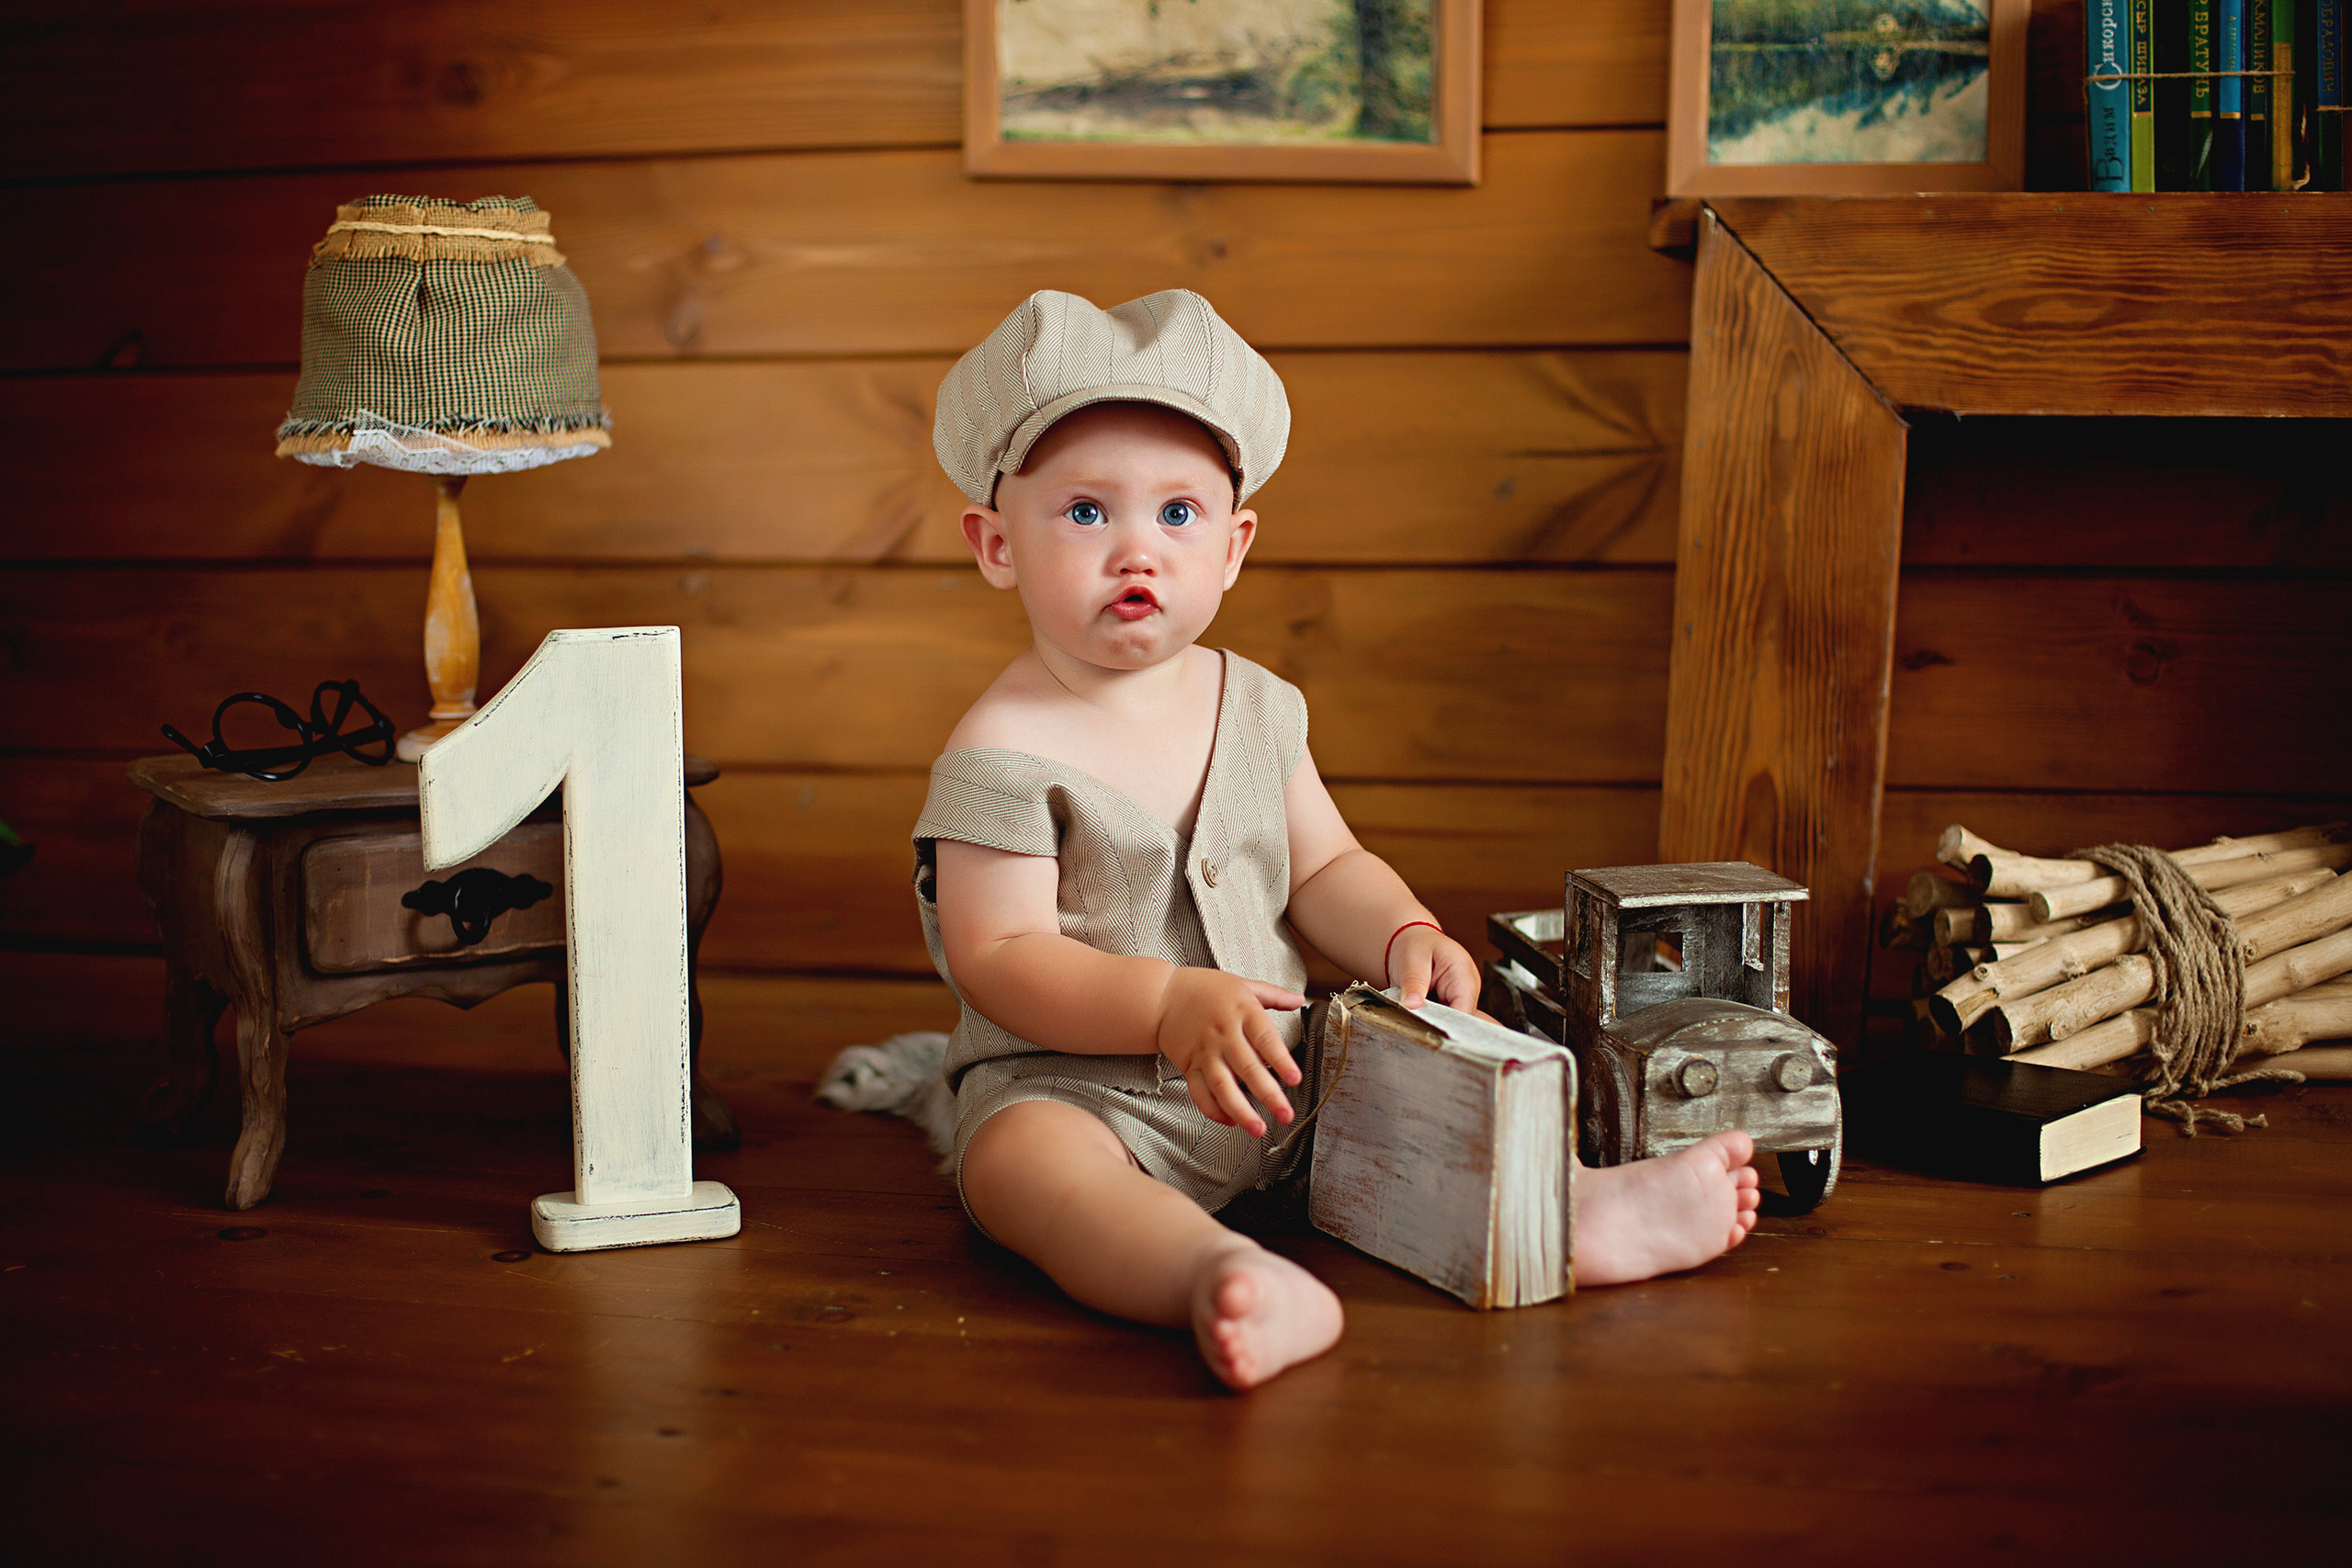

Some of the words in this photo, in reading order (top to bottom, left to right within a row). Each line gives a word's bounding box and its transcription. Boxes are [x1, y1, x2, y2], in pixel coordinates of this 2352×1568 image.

[2195, 11, 2210, 98] БРАТУНЬ
[2096, 107, 2123, 184] Вадим
[419, 626, 695, 1206] 1
